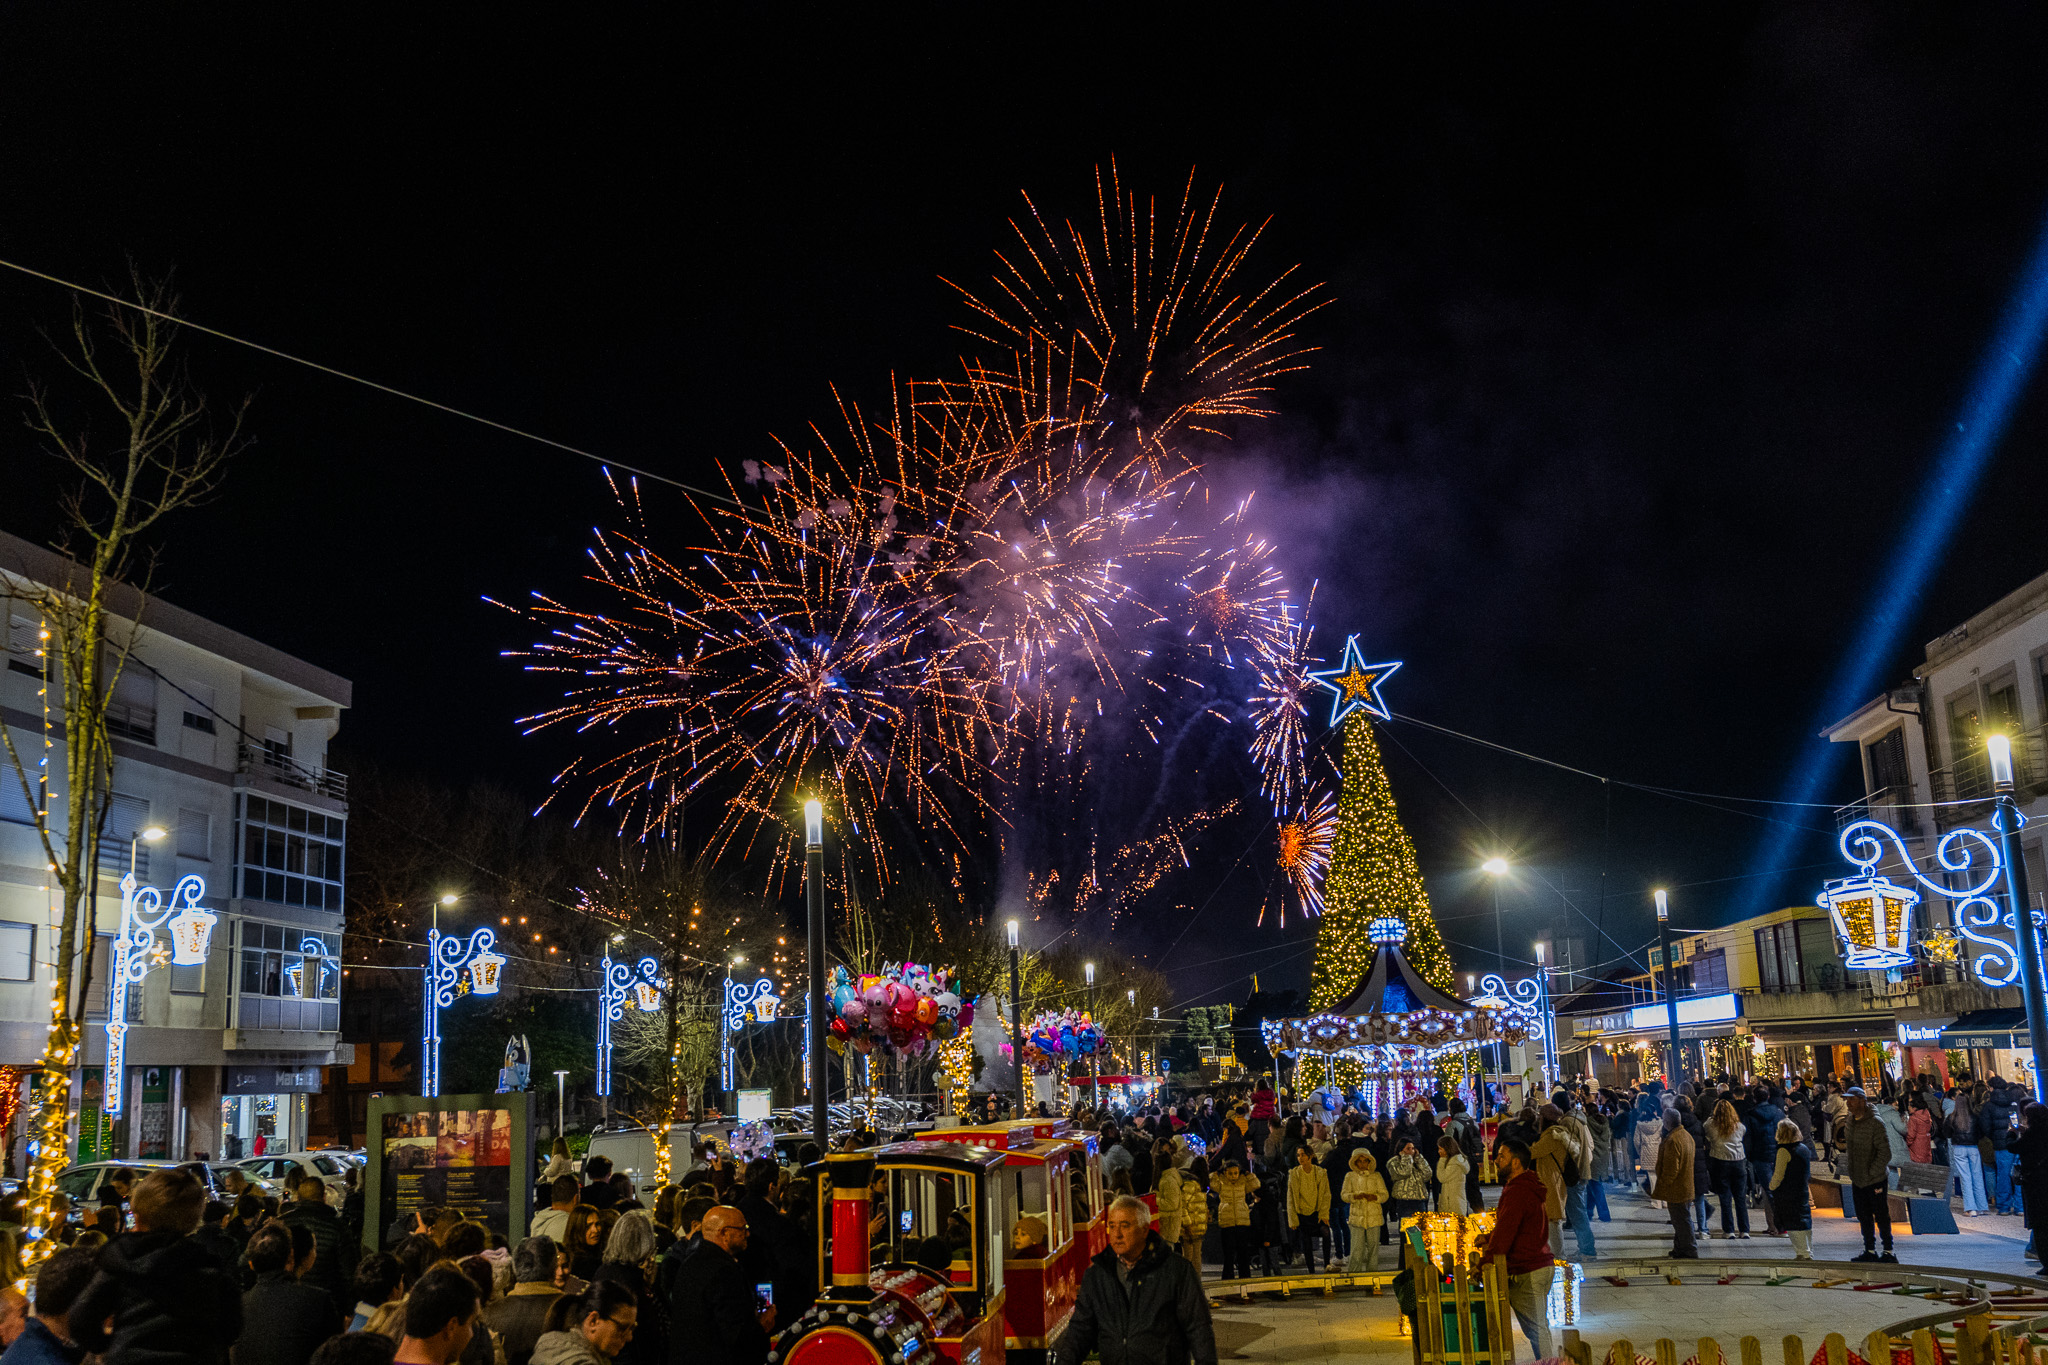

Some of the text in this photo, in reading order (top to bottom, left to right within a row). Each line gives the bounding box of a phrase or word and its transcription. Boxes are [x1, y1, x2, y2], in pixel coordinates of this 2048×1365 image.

[1955, 1037, 1993, 1047] LOJA CHINESA
[491, 1139, 510, 1150] DA
